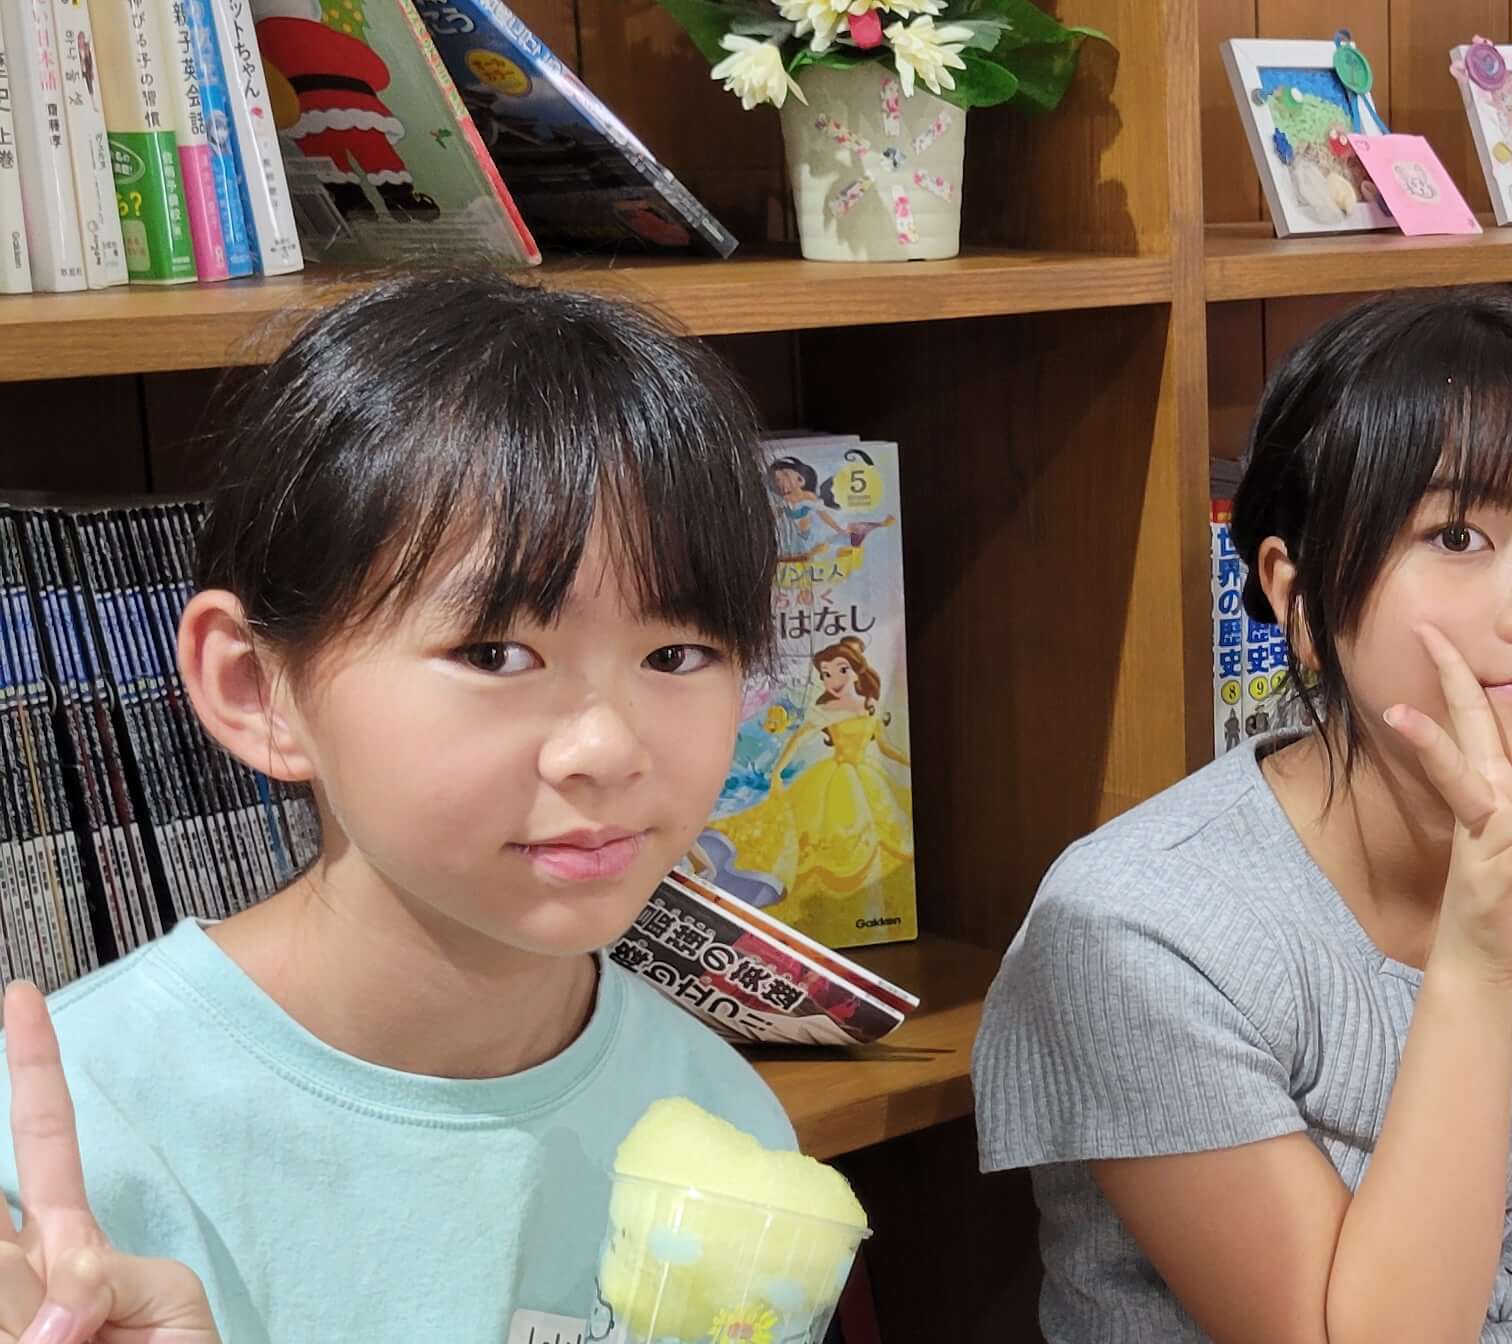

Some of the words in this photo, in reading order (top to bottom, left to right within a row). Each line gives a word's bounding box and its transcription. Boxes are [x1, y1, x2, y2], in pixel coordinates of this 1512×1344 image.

[849, 469, 868, 494] 5
[780, 605, 876, 641] はなし
[855, 915, 902, 930] Gakken
